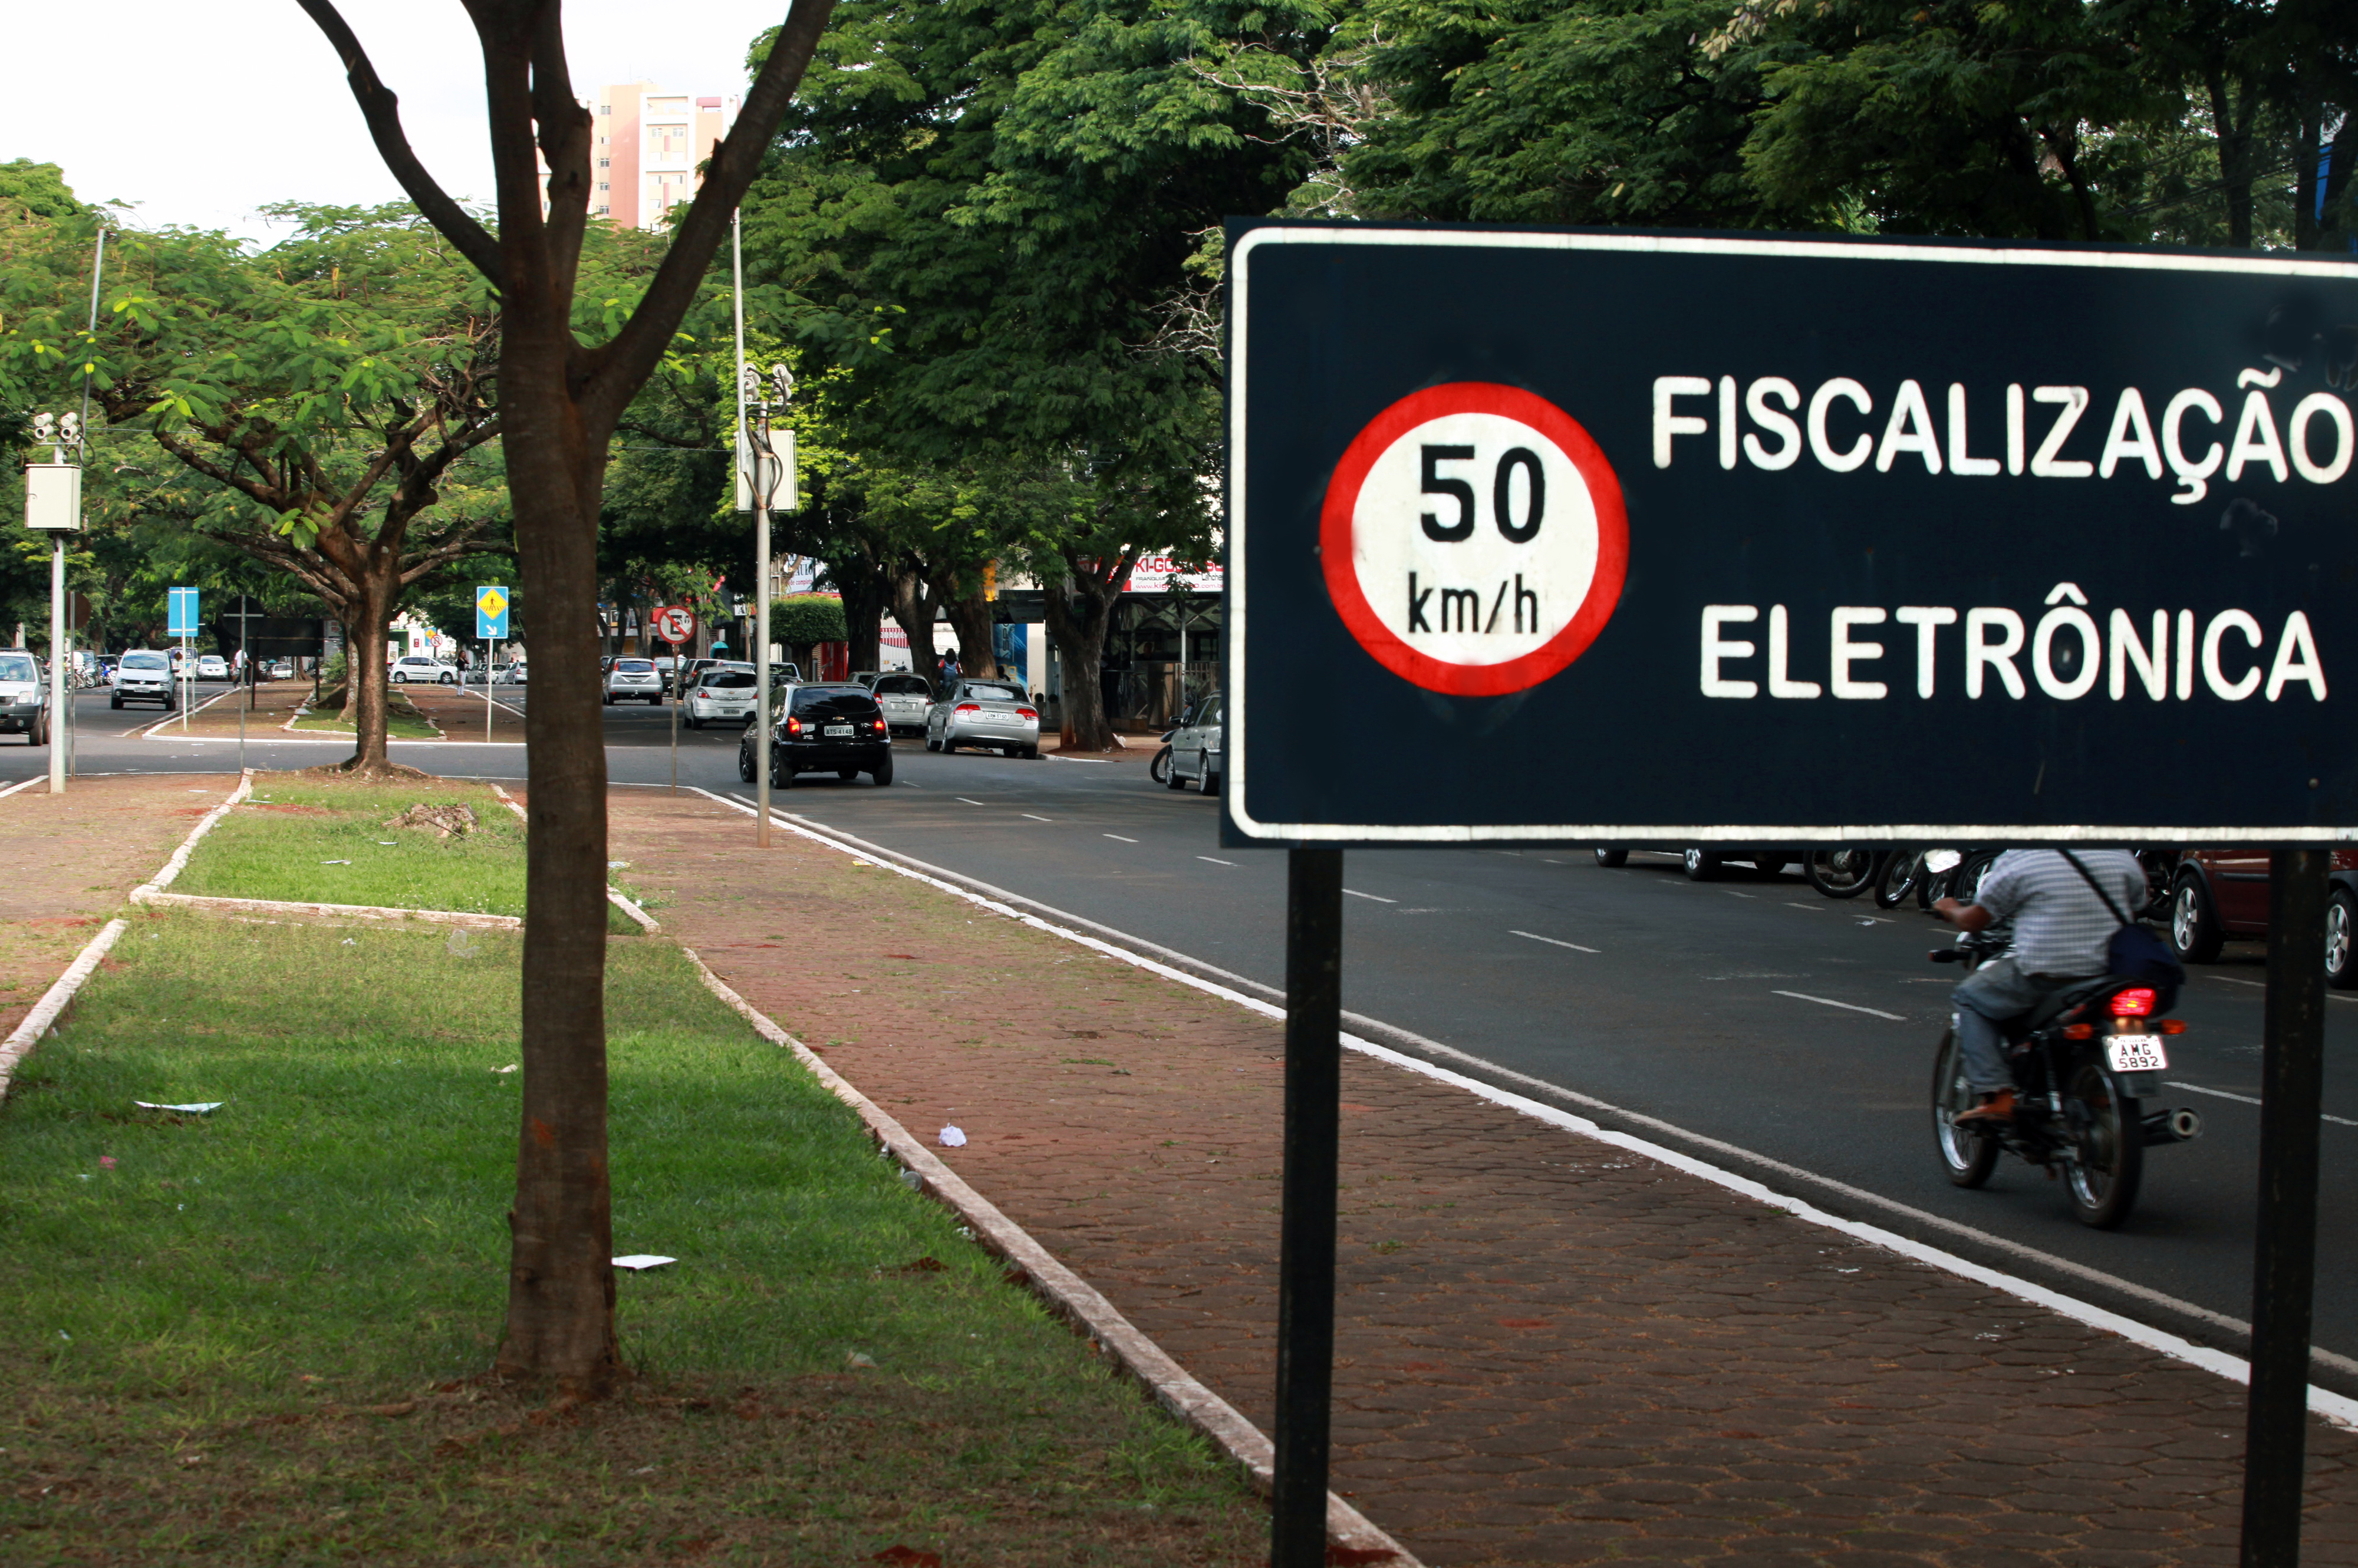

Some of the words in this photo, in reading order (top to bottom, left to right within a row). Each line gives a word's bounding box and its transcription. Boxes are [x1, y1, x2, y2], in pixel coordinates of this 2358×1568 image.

[1654, 368, 2353, 504] FISCALIZAÇÃO
[1421, 445, 1544, 543] 50
[795, 564, 813, 576] AULO
[1409, 572, 1537, 633] km/h
[1701, 583, 2326, 701] ELETRÔNICA
[2119, 1056, 2159, 1068] 5892
[2121, 1043, 2151, 1056] AMG
